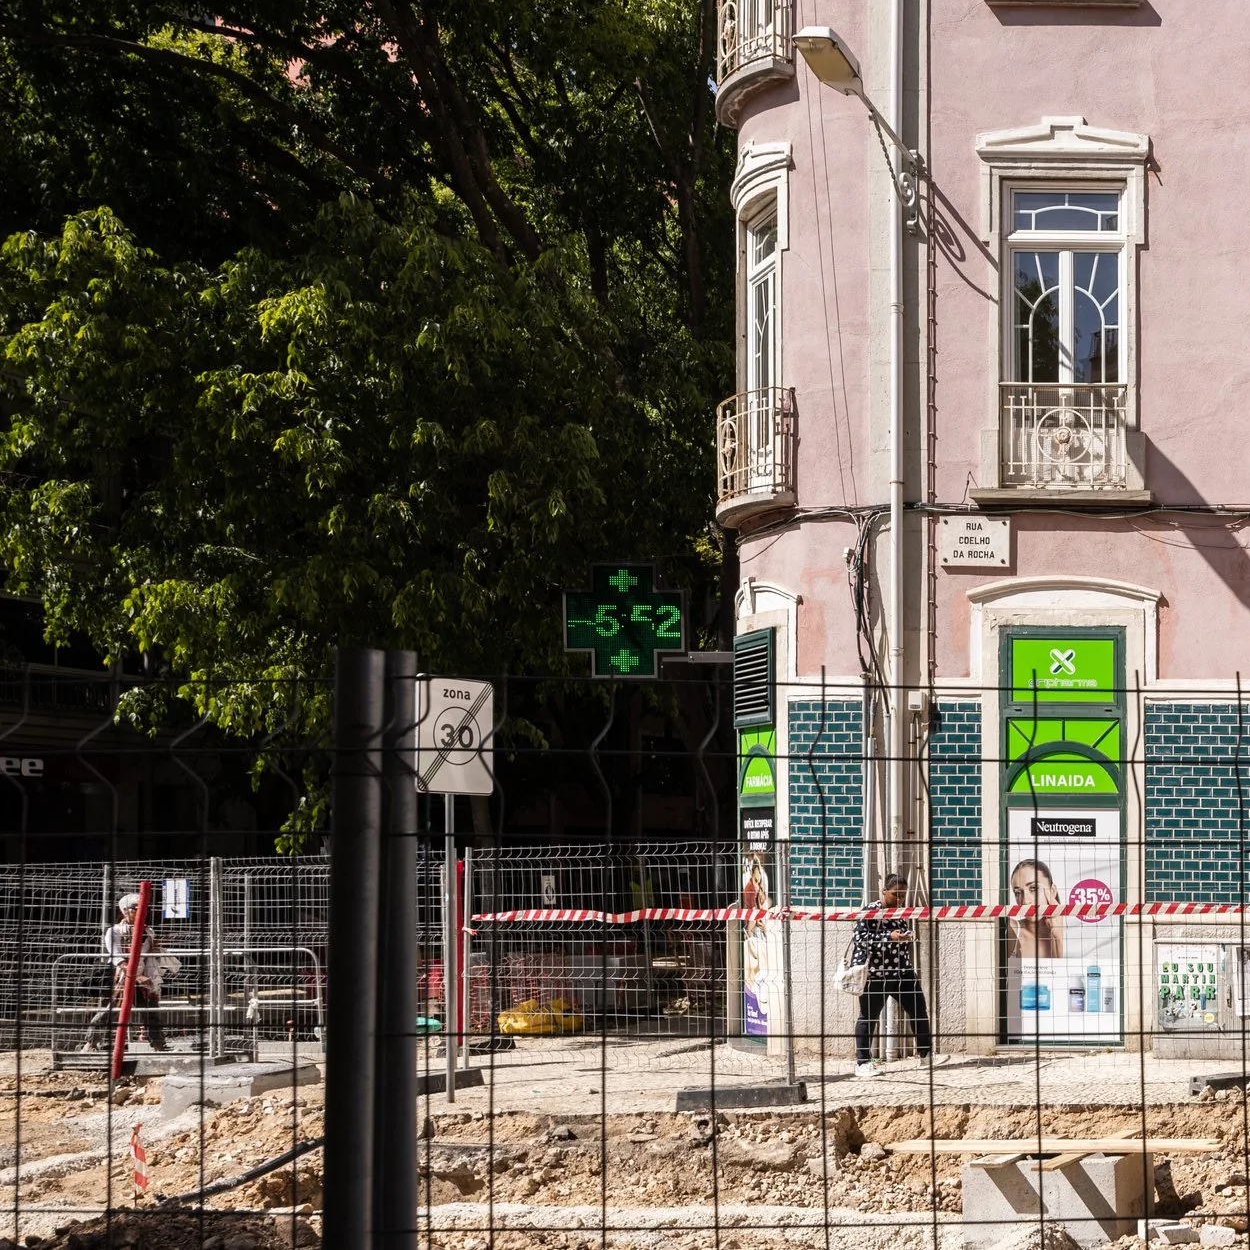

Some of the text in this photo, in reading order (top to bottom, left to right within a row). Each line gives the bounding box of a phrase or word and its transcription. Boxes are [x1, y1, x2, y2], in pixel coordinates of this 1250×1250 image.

[966, 522, 983, 531] RUA
[958, 536, 991, 545] COELHO
[953, 550, 995, 559] DA ROCHA
[442, 688, 472, 701] zona
[440, 723, 475, 749] 30
[745, 772, 773, 788] FARMÁCIA
[1030, 774, 1096, 787] LINAIDA
[1036, 820, 1093, 836] Neutrogena
[1162, 962, 1214, 973] EU SOU
[1160, 974, 1216, 985] MARTIN
[1159, 985, 1217, 1001] PARR
